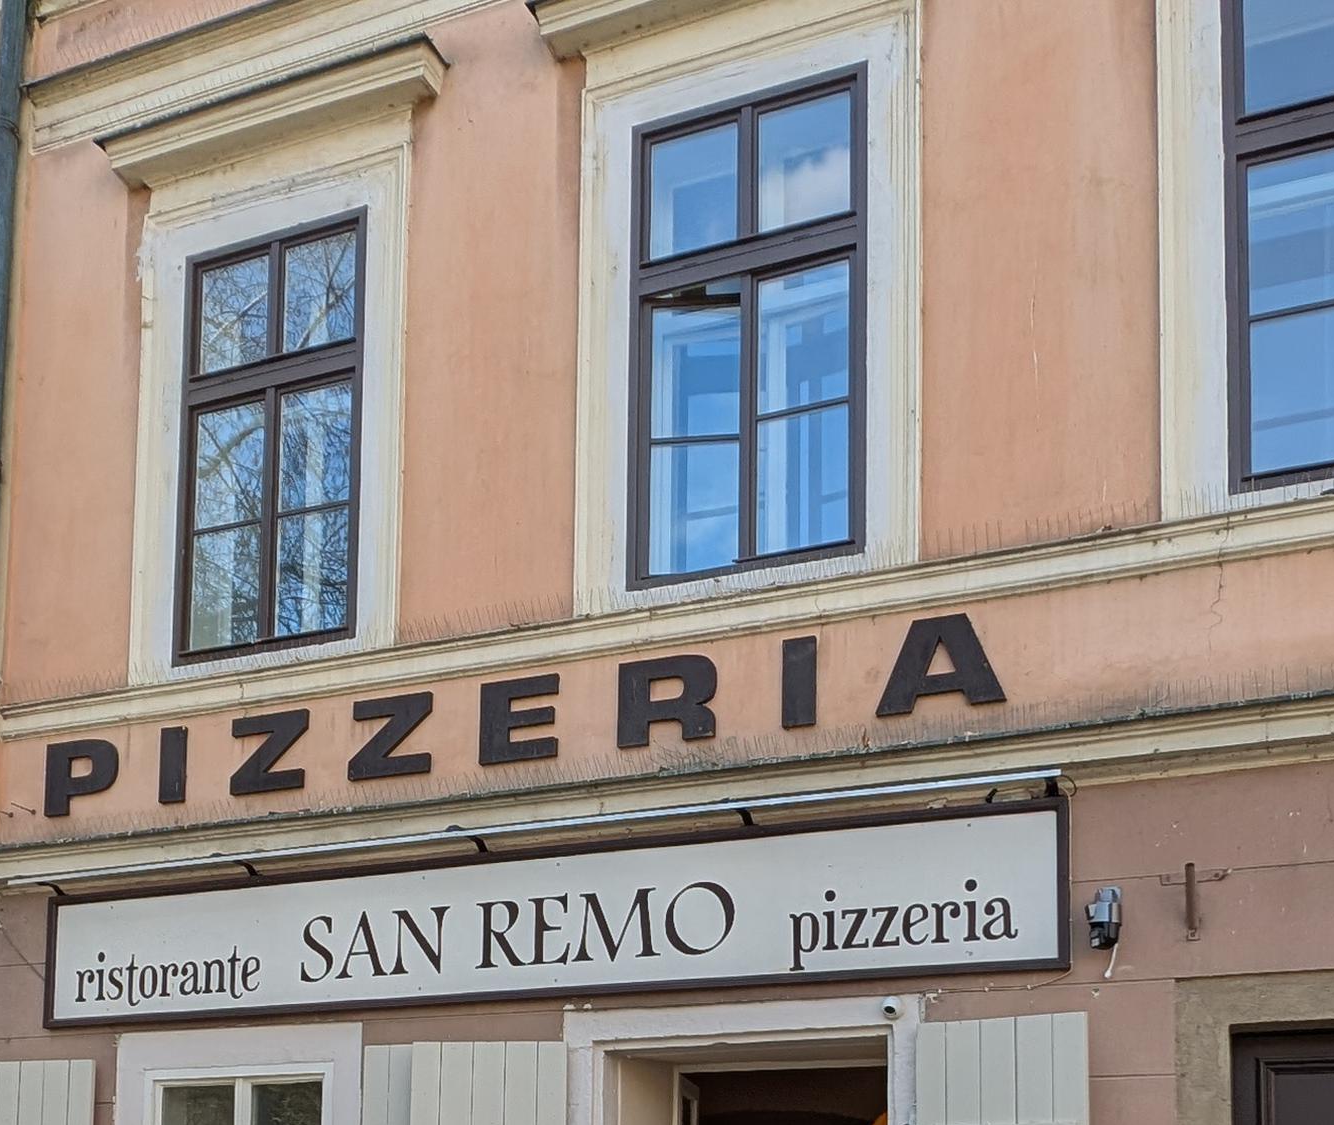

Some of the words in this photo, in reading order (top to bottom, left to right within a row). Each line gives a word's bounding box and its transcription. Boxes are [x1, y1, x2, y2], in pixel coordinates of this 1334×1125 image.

[44, 613, 1007, 817] PIZZERIA
[75, 945, 261, 1006] ristorante
[300, 905, 451, 983] SAN
[475, 881, 735, 970] REMO
[789, 879, 1019, 971] pizzeria
